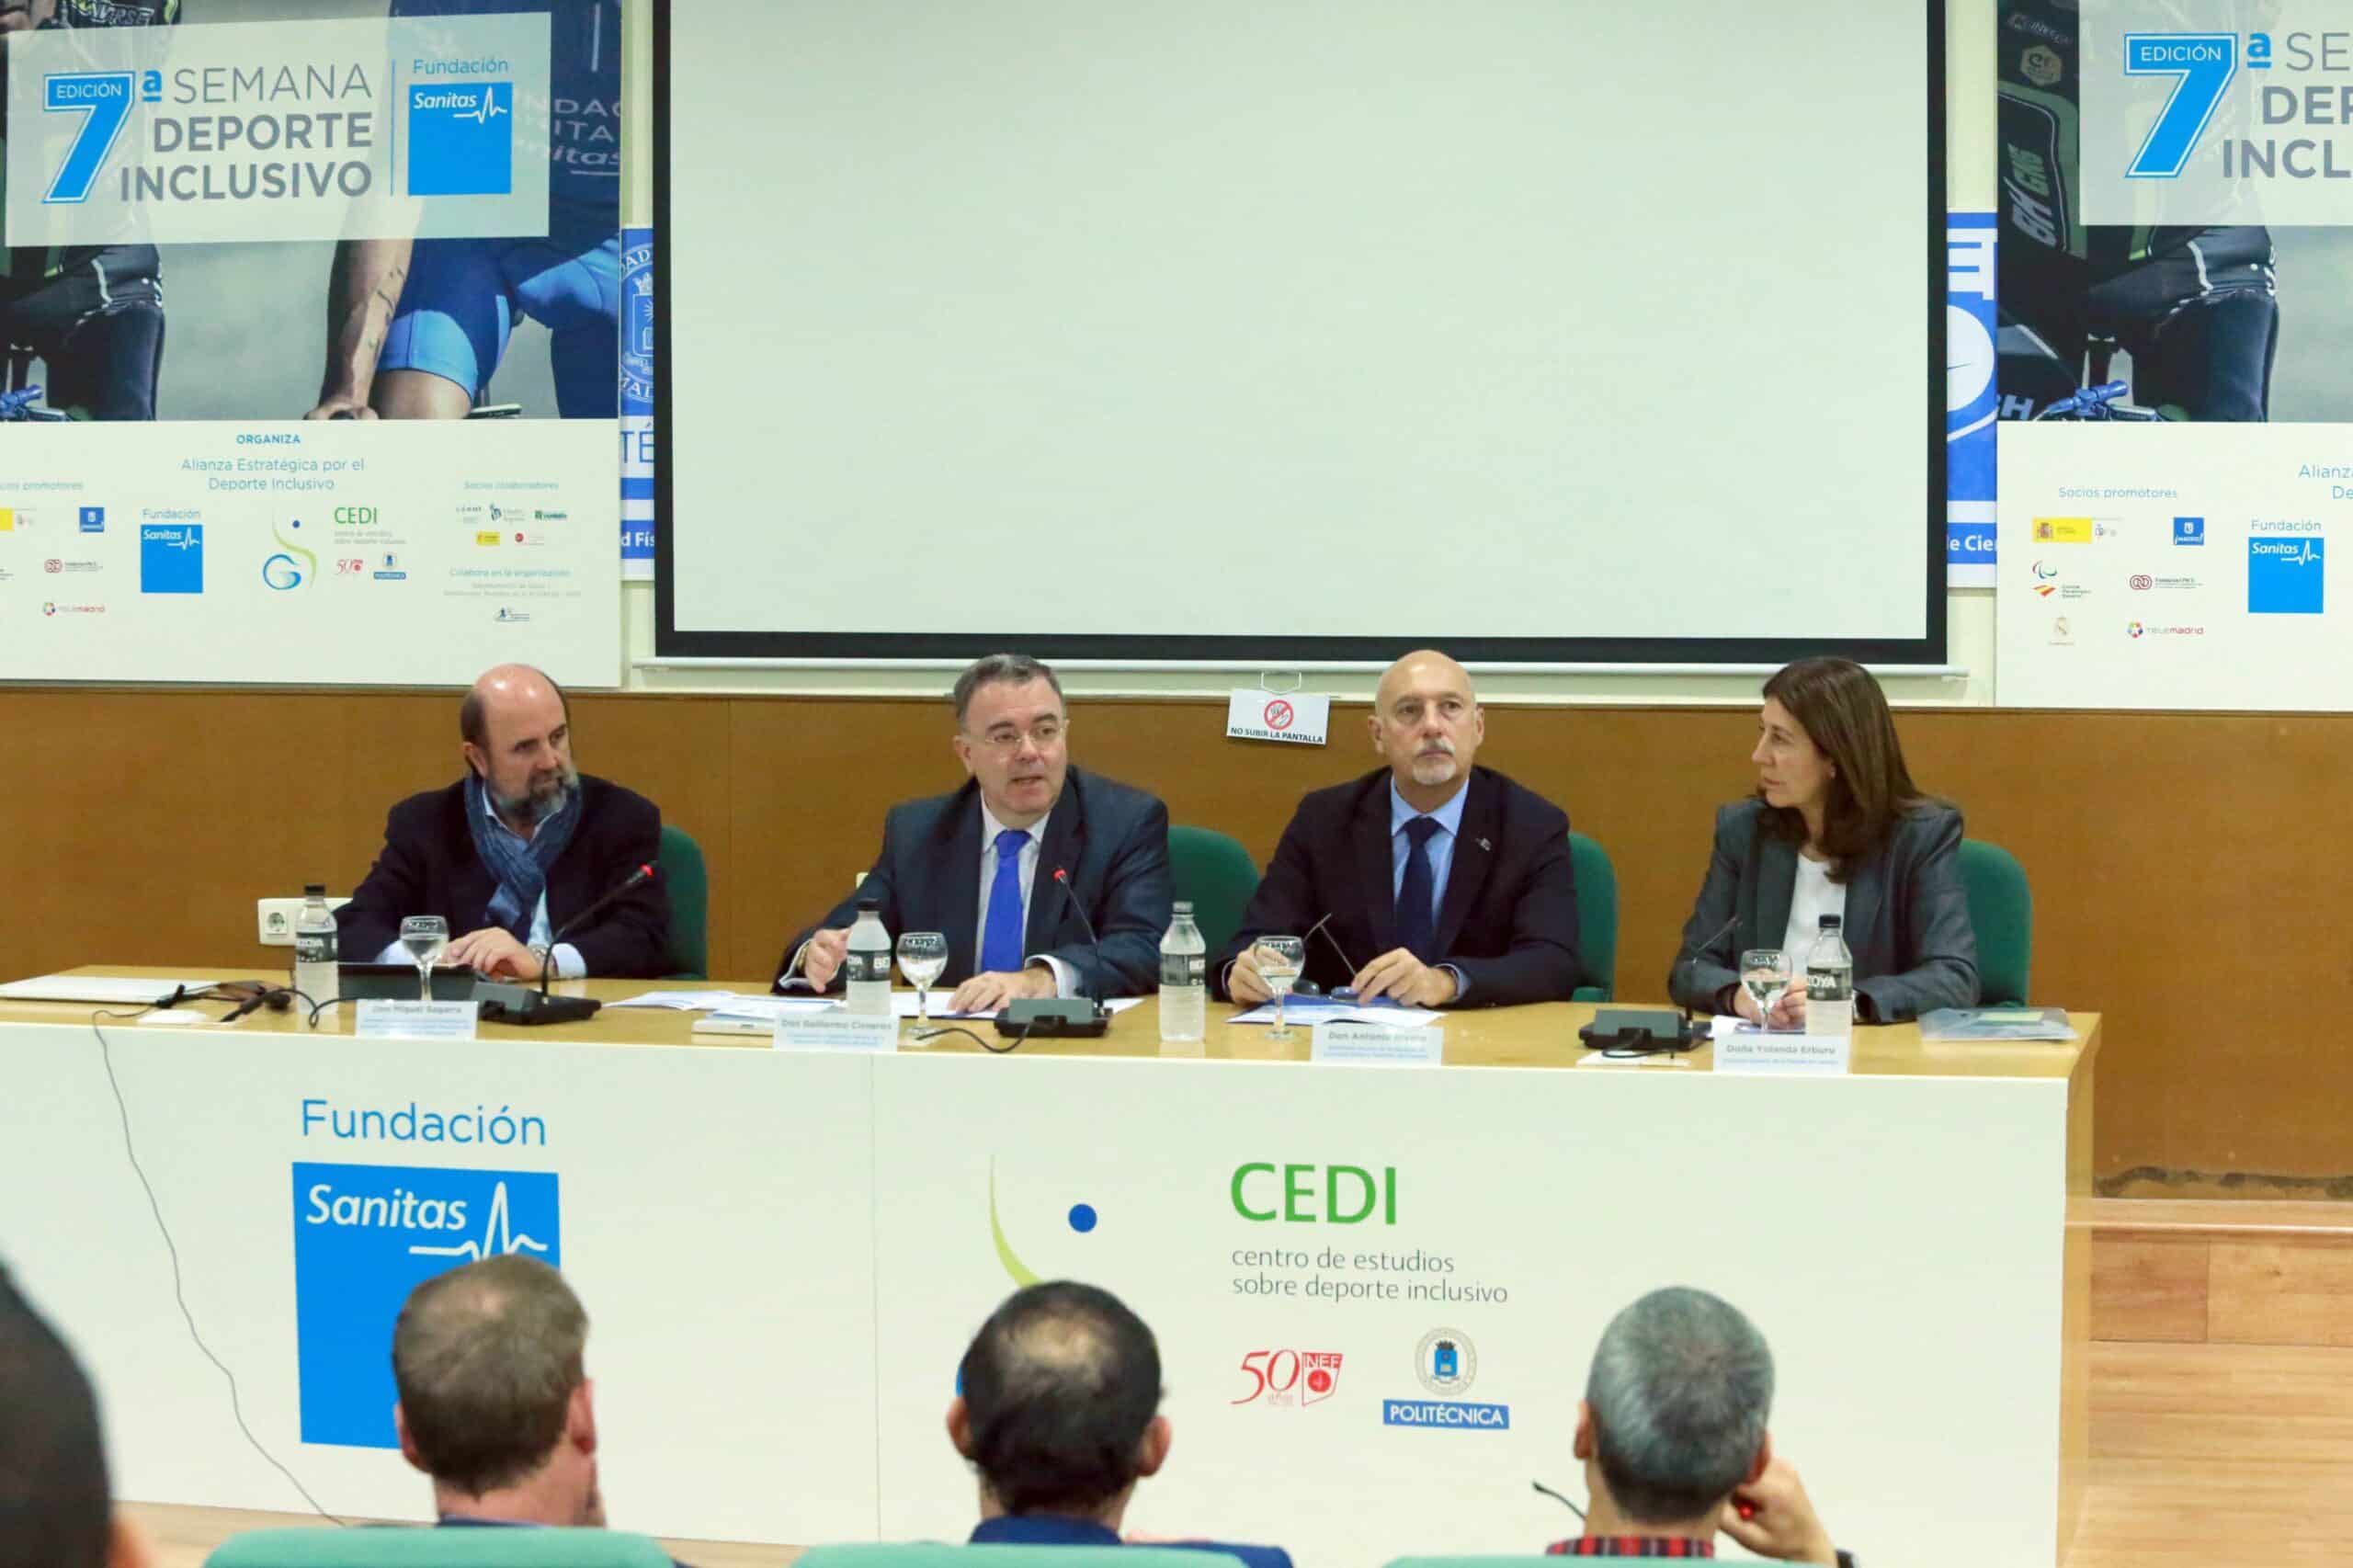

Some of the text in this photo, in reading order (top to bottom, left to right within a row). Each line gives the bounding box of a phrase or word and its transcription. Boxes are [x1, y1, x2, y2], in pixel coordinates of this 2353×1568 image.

[2140, 44, 2222, 62] EDICIÓN
[413, 57, 508, 74] Fundación
[56, 83, 122, 98] EDICIÓN
[173, 63, 372, 104] SEMANA
[414, 92, 478, 109] Sanitas
[154, 112, 372, 153] DEPORTE
[119, 161, 372, 201] INCLUSIVO
[236, 434, 301, 445] ORGANIZA
[181, 459, 365, 474] Alianza Estratégica por el
[208, 477, 335, 494] Deporte Inclusivo
[2059, 486, 2177, 500] Socios promotores
[335, 506, 378, 524] CEDI
[2251, 519, 2322, 531] Fundación
[143, 529, 182, 540] Sanitas
[2252, 542, 2299, 554] Sanitas
[1231, 727, 1324, 744] NO SUBIR LA PANTALLA
[302, 1098, 546, 1146] Fundación
[1231, 1162, 1397, 1225] CEDI
[306, 1183, 468, 1232] Sanitas
[1232, 1245, 1455, 1273] centro de estudios
[1232, 1271, 1508, 1304] sobre deporte inclusivo
[1230, 1348, 1301, 1405] 50
[1390, 1403, 1504, 1426] POLITÉCNICA
